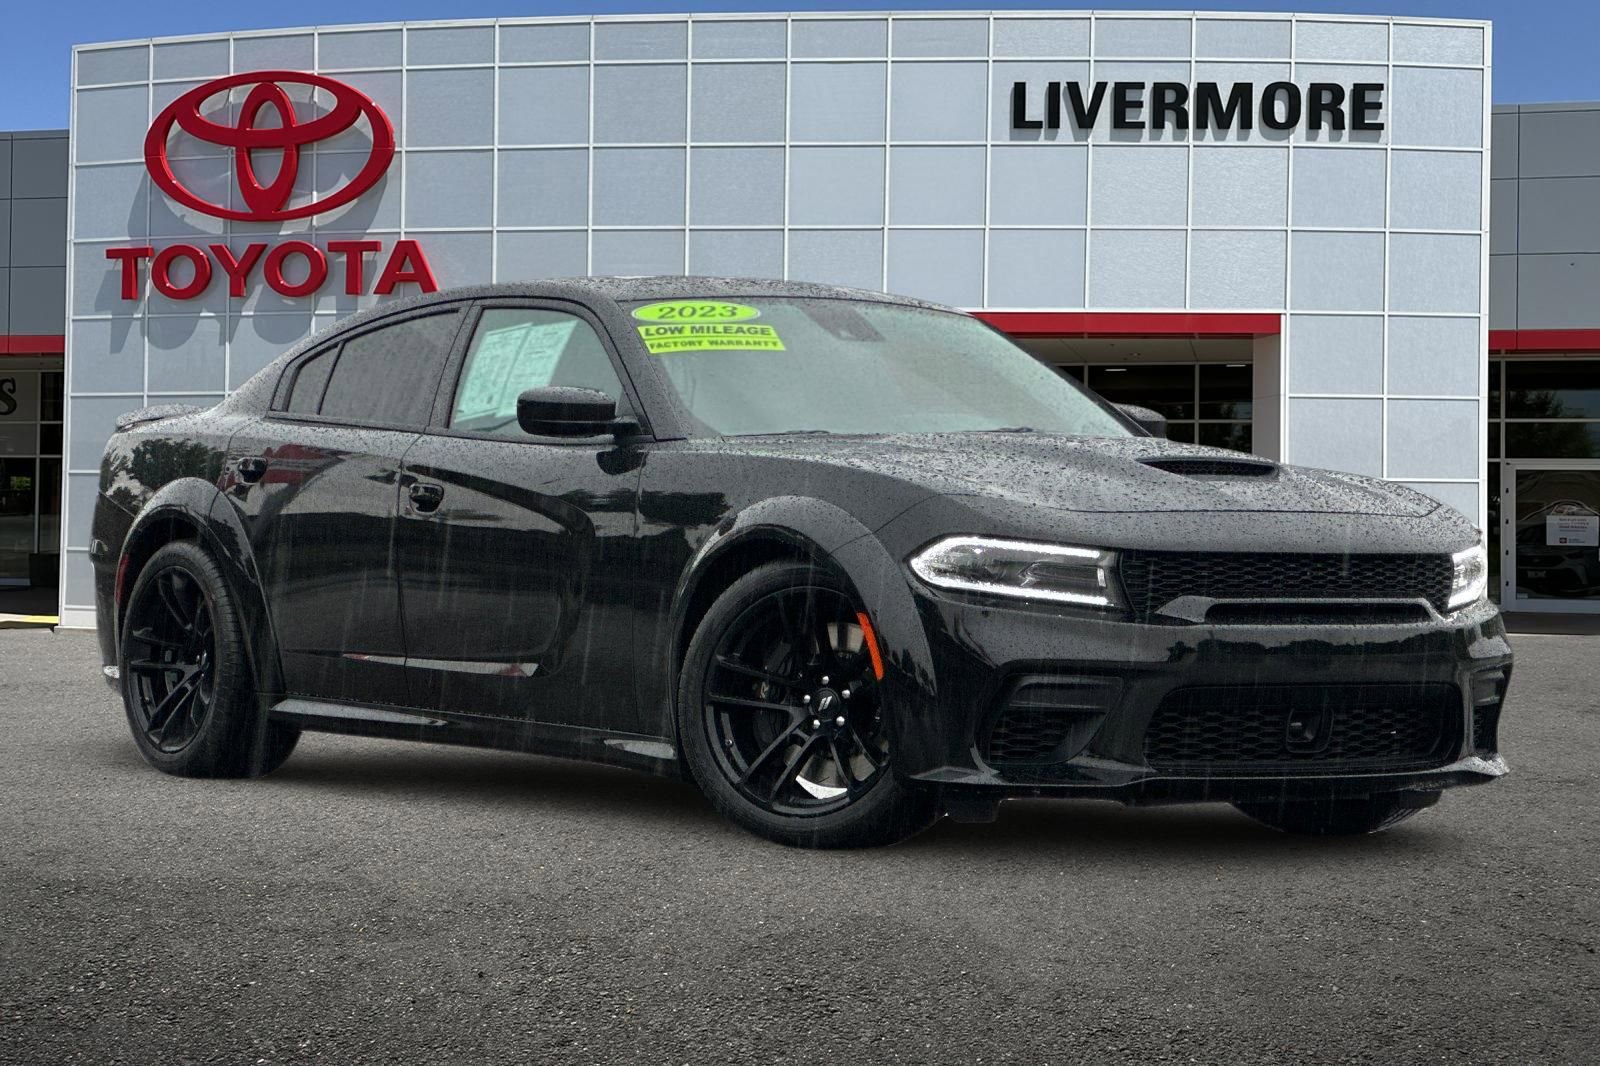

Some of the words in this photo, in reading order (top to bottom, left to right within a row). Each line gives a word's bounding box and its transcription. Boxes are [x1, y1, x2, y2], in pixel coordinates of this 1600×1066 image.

[1013, 81, 1385, 131] LIVERMORE
[106, 240, 439, 300] TOYOTA
[657, 305, 738, 319] 2023
[644, 326, 685, 337] LOW
[690, 325, 773, 336] MILEAGE
[649, 340, 703, 349] FACTORY
[708, 339, 779, 347] WARRANTY
